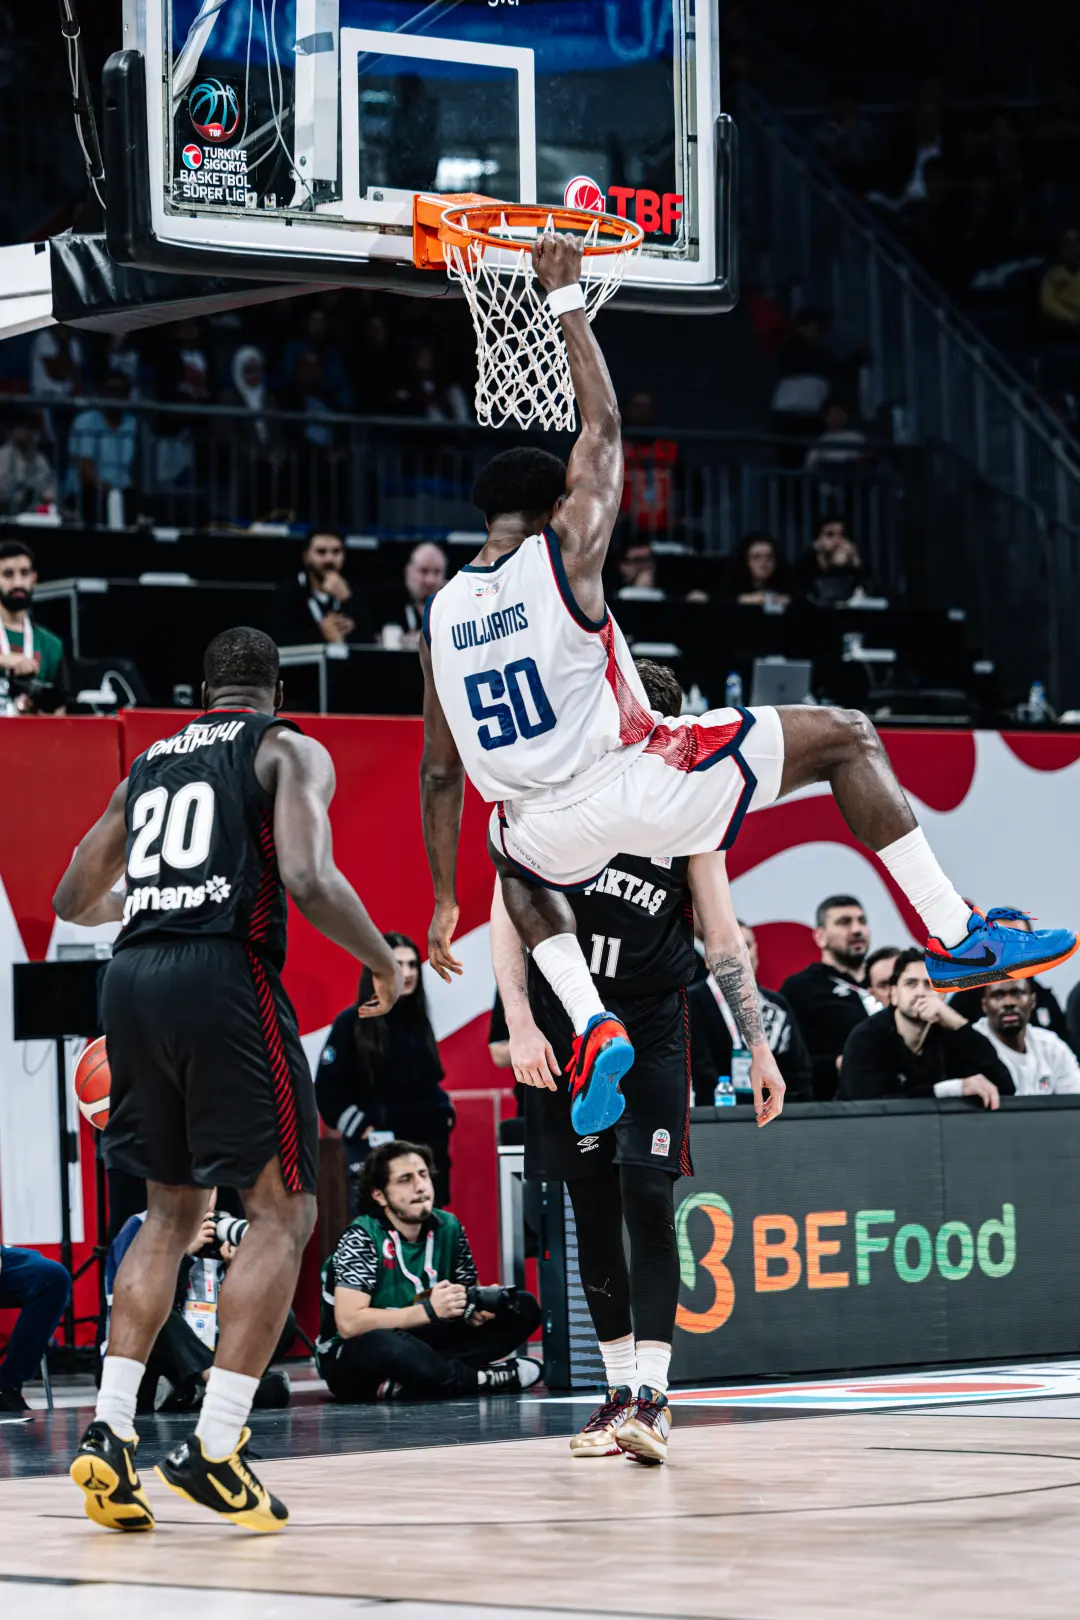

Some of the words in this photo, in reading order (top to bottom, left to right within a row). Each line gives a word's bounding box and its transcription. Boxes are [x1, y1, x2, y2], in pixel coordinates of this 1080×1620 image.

[208, 128, 222, 137] TBF
[180, 169, 251, 188] BASKETBOL
[608, 186, 684, 235] TBF
[451, 602, 529, 651] WILLIAMS
[464, 657, 557, 751] 50
[128, 781, 215, 879] 20
[590, 933, 622, 978] 11
[580, 1143, 599, 1154] umbro
[752, 1202, 1017, 1293] BEFood
